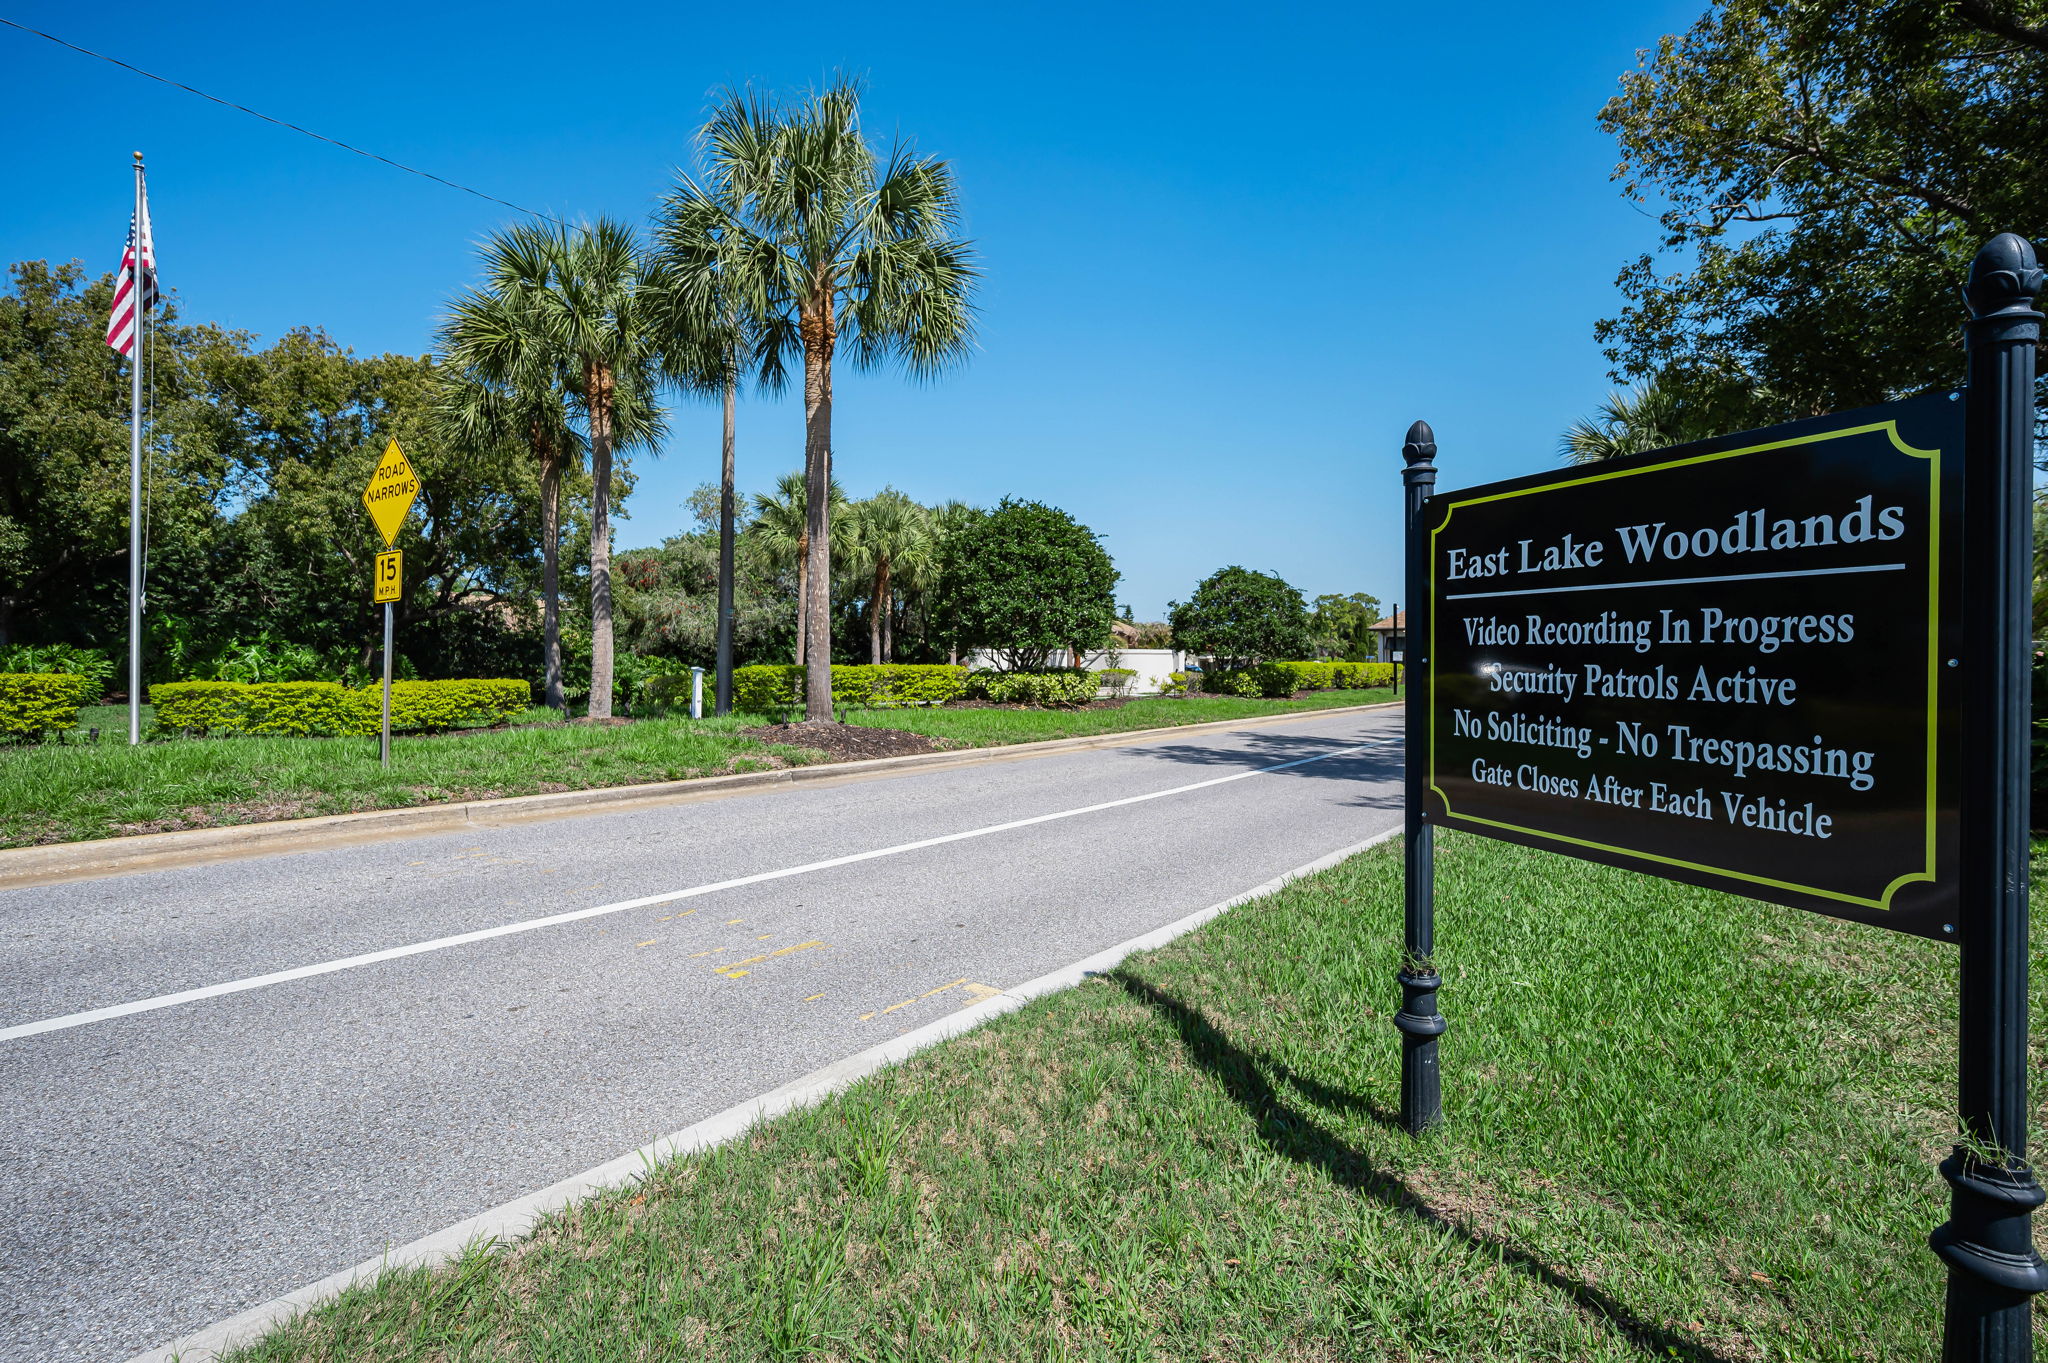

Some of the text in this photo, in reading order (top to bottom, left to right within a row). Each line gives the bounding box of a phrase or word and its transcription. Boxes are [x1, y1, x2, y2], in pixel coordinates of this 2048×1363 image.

[367, 479, 415, 504] NARROWS
[378, 461, 405, 482] ROAD
[1447, 493, 1905, 580] East Lake Woodlands
[380, 557, 397, 582] 15
[1463, 607, 1854, 654] Video Recording In Progress
[1490, 662, 1797, 706] Security Patrols Active
[1453, 708, 1482, 740] No
[1487, 711, 1592, 759] Soliciting
[1616, 721, 1658, 758] No
[1667, 724, 1875, 791] Trespassing
[1471, 757, 1833, 839] Gate Closes After Each Vehicle
